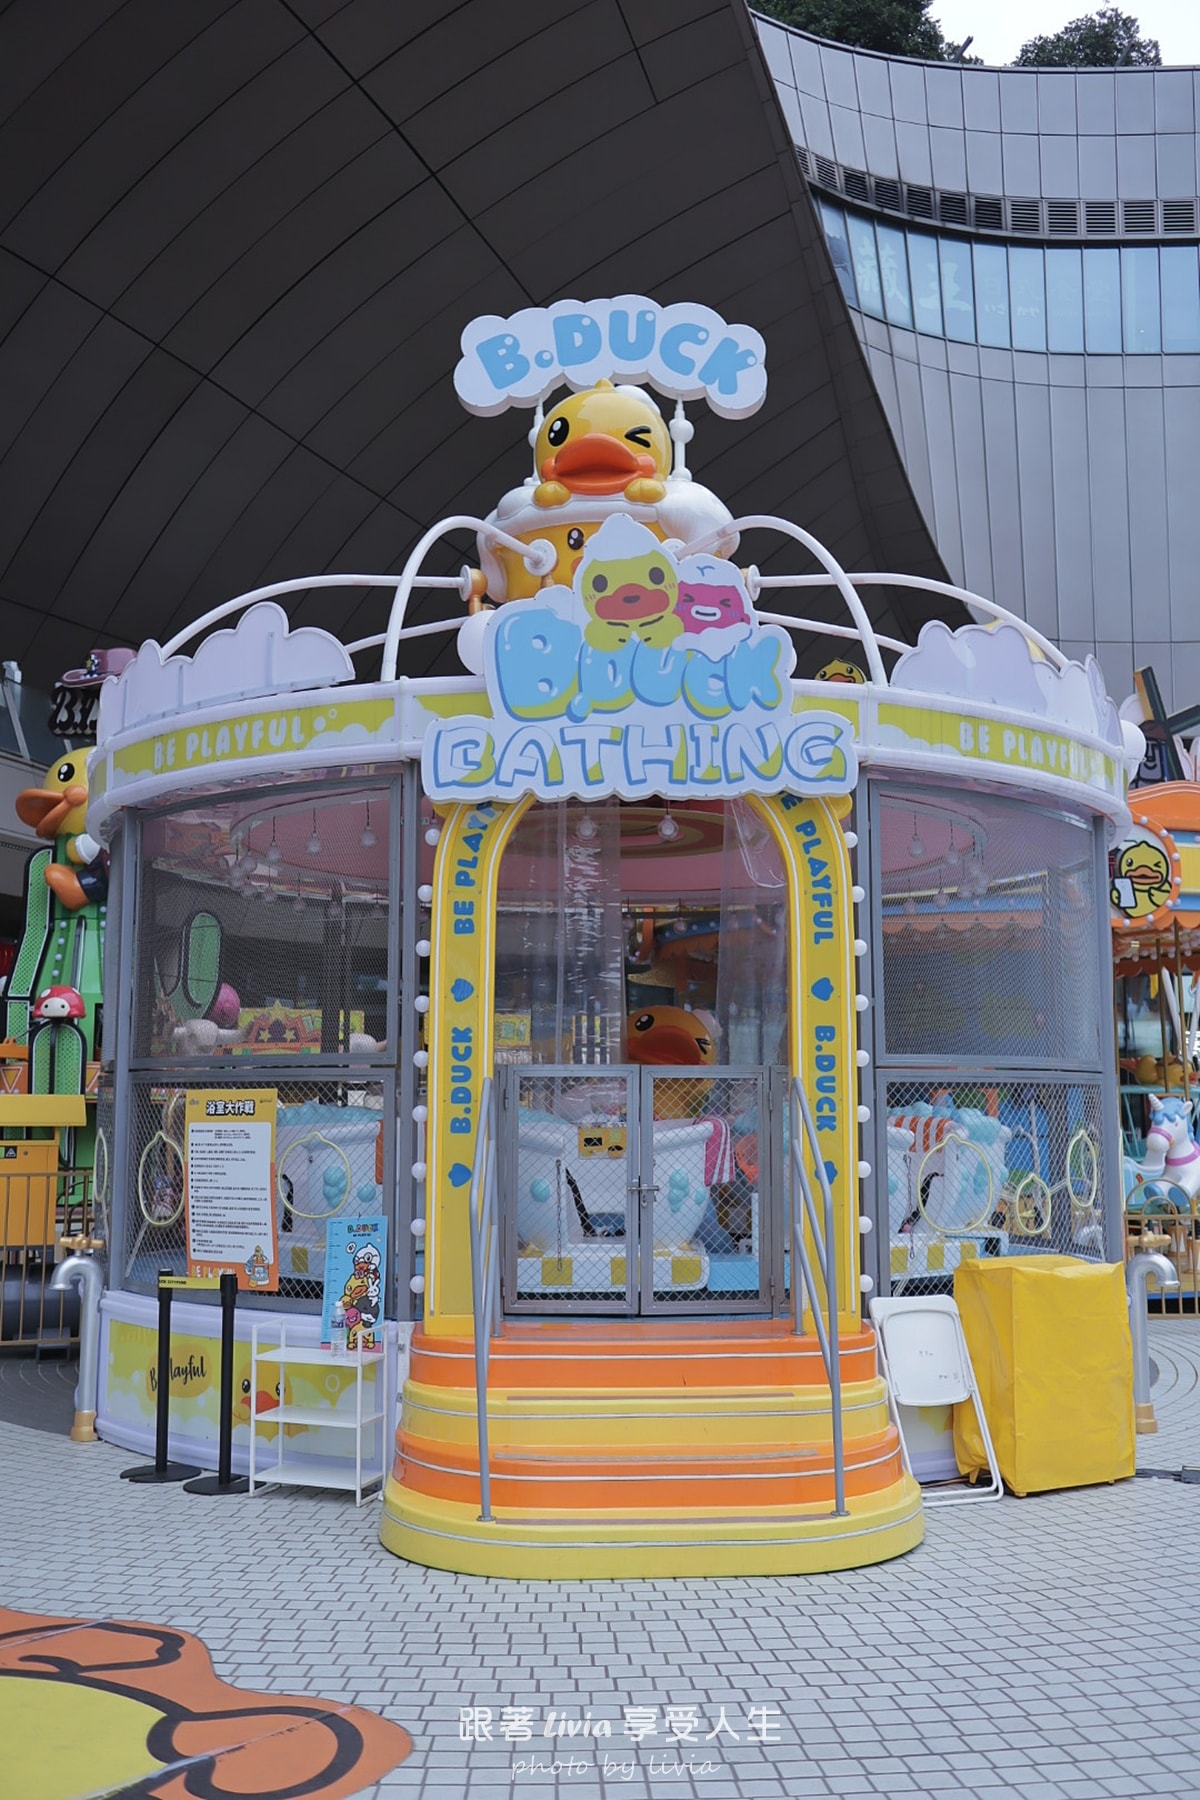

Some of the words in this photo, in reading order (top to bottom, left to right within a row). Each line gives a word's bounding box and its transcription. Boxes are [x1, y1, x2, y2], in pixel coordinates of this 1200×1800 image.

[476, 309, 758, 394] B.DUCK
[494, 608, 783, 722] B.DUCK
[154, 737, 175, 769] BE
[186, 715, 304, 760] PLAYFUL
[433, 721, 848, 788] BATHING
[959, 722, 990, 754] BE
[1003, 730, 1088, 777] PLAYFUL
[779, 794, 803, 810] E
[795, 819, 834, 945] PLAYFUL
[453, 901, 475, 934] BE
[450, 1026, 473, 1134] B.DUCK
[815, 1025, 837, 1132] B.DUCK
[150, 1366, 158, 1391] B
[169, 1354, 207, 1385] layful
